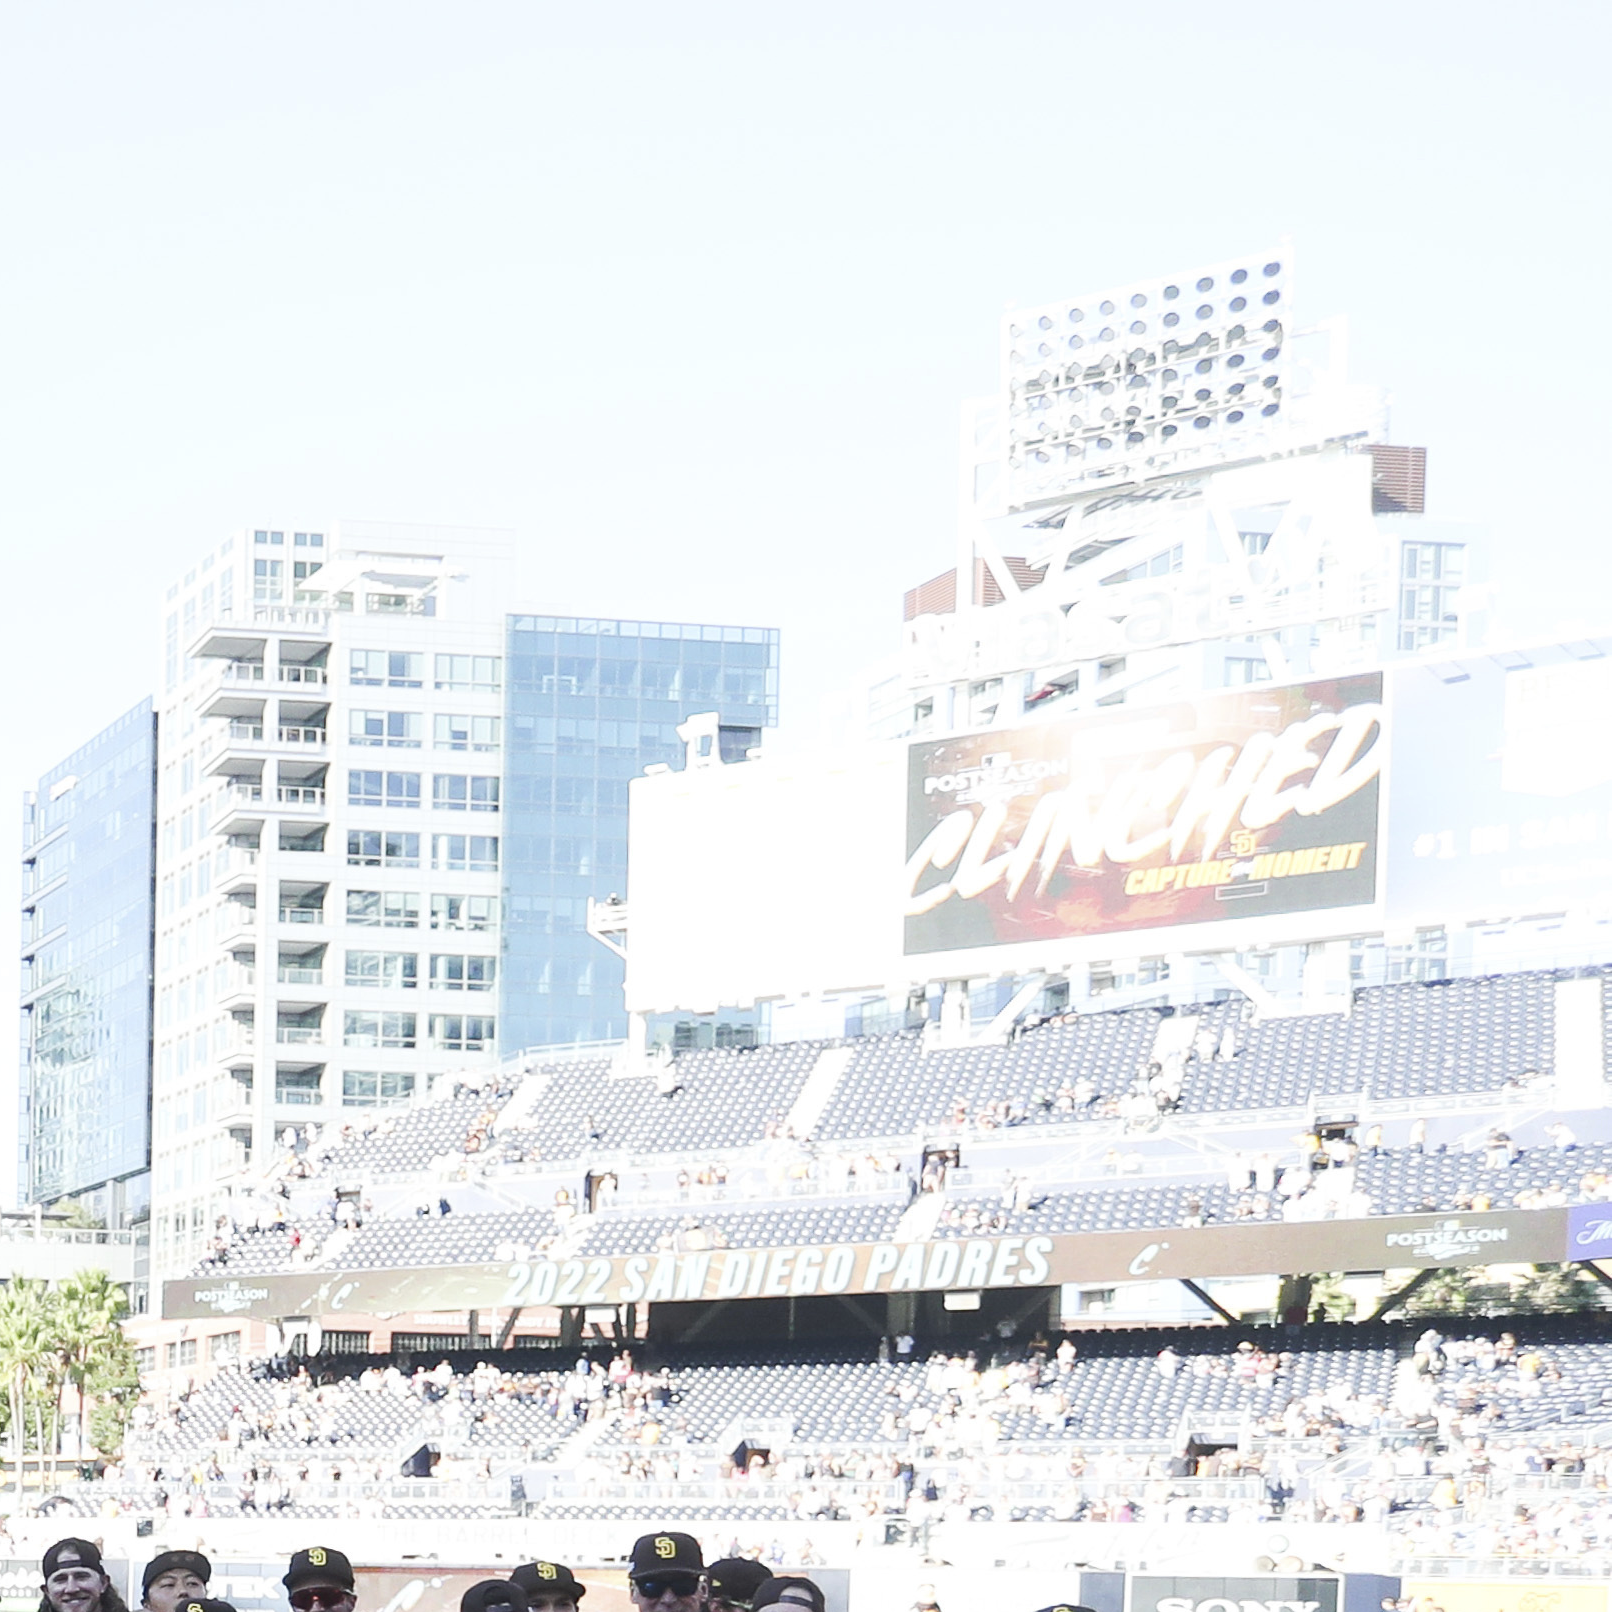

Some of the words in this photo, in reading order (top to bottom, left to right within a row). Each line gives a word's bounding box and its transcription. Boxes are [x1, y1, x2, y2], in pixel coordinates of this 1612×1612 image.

[925, 758, 1069, 795] POSTSEASON
[905, 703, 1381, 916] CLINCHED
[1126, 855, 1235, 895] CAPTURE
[1251, 842, 1367, 881] MOMENT
[1385, 1227, 1509, 1248] POSTSEASON
[505, 1259, 610, 1305] 2022
[619, 1252, 709, 1300] SAN
[723, 1244, 852, 1295] DIEGO
[865, 1237, 1053, 1289] PADRES
